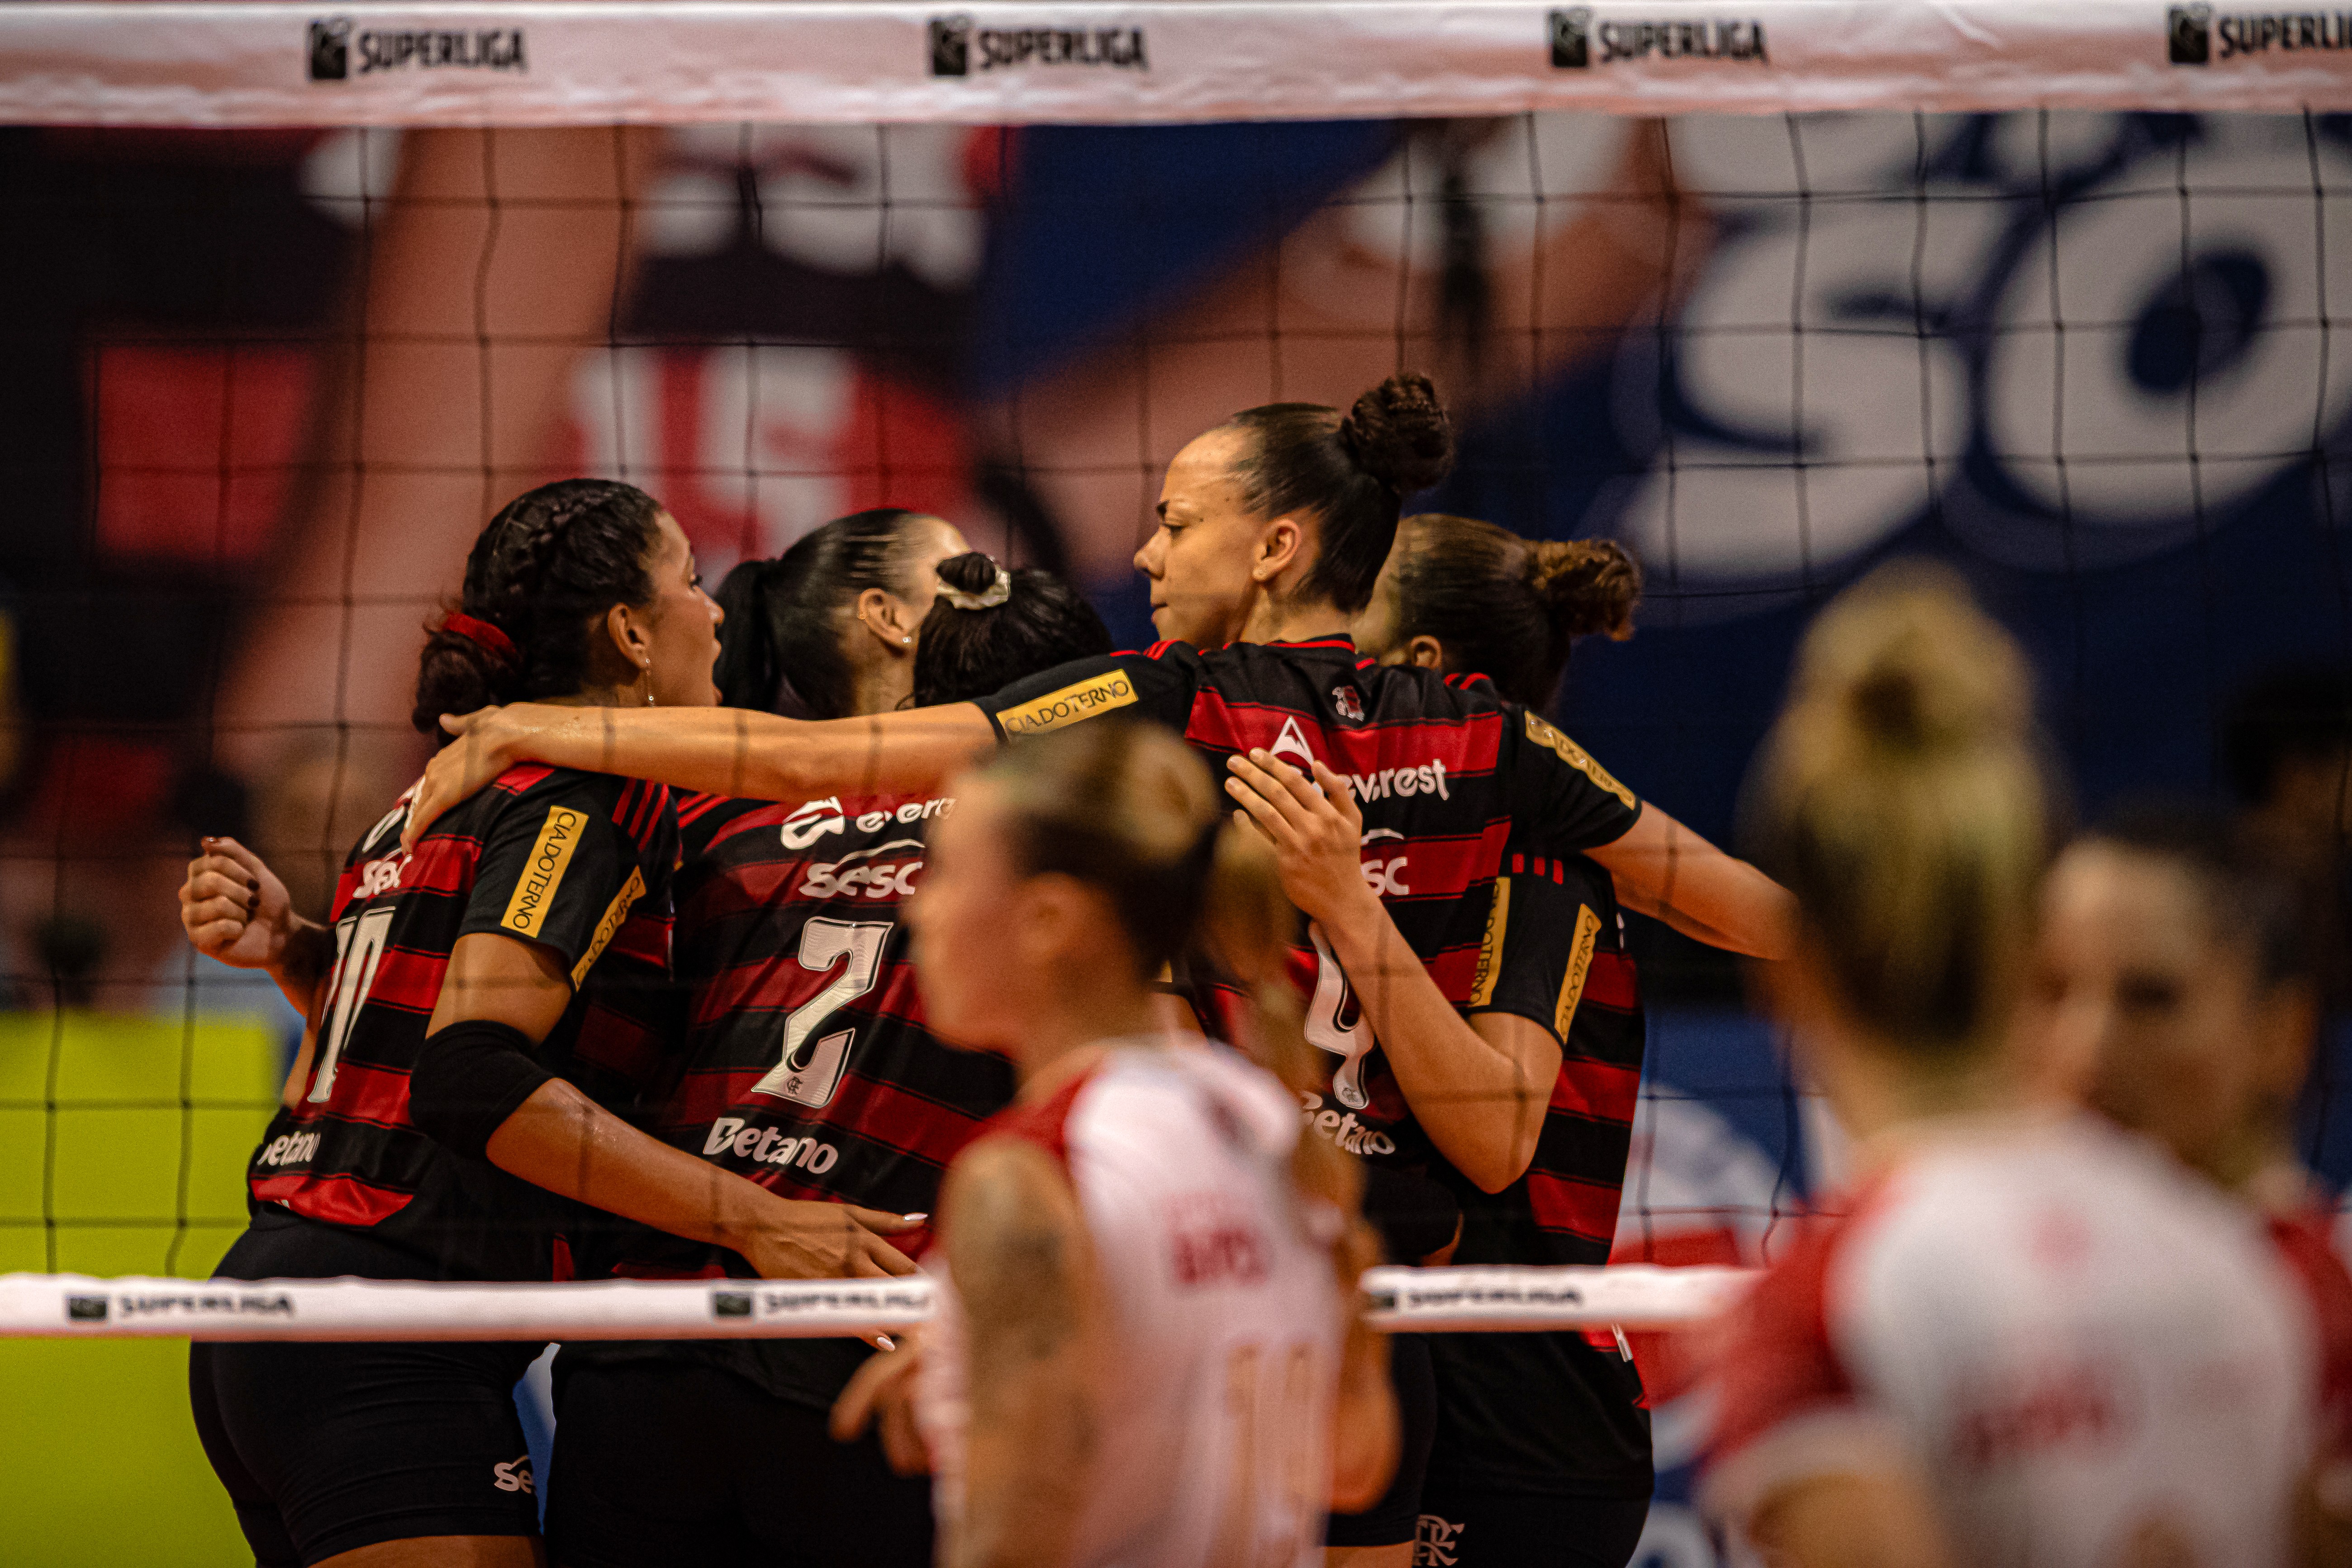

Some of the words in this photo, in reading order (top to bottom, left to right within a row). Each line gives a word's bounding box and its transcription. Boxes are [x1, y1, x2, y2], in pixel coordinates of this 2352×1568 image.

[356, 28, 530, 74] SUPERLIGA
[978, 26, 1150, 71] SUPERLIGA
[1600, 18, 1771, 66] SUPERLIGA
[2219, 13, 2352, 62] SUPERLI
[751, 916, 894, 1109] 2
[702, 1117, 838, 1174] Betano
